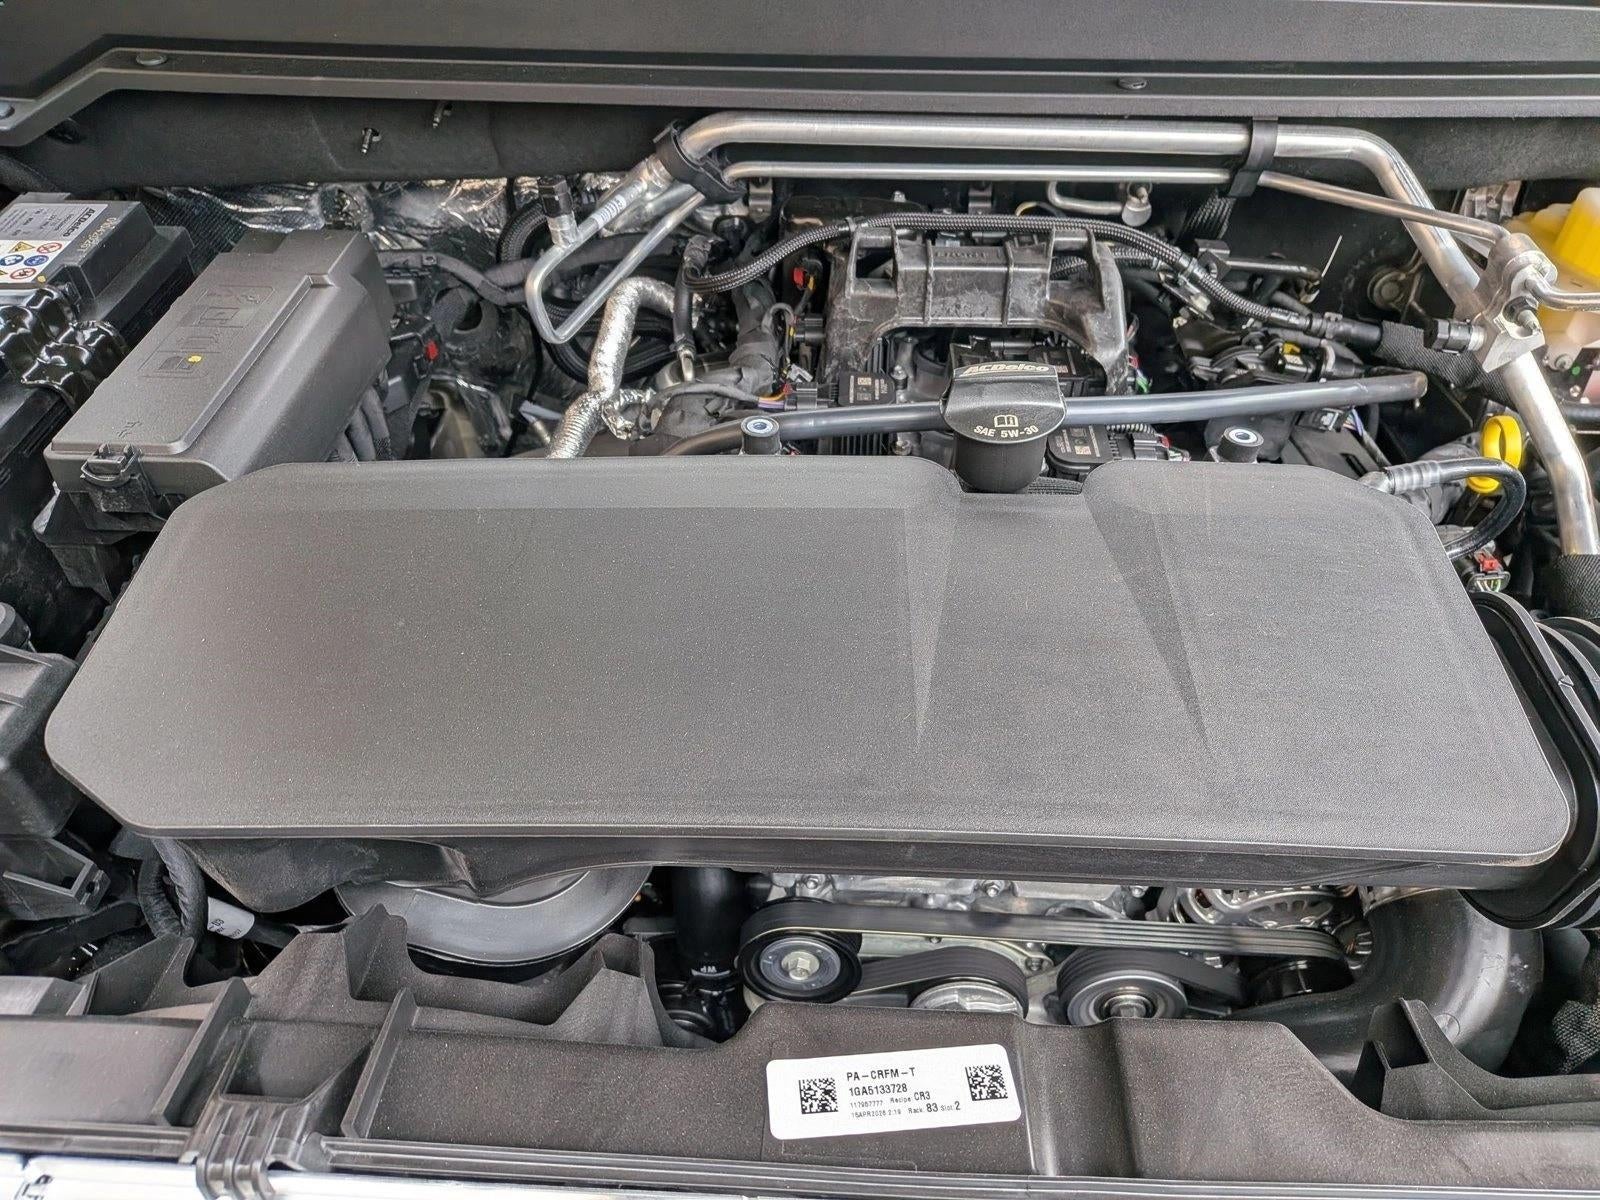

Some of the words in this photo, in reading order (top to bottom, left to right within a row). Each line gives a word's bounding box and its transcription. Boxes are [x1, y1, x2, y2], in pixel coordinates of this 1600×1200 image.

[63, 208, 95, 237] ACDelco
[962, 363, 1050, 375] ACDelco
[973, 425, 996, 438] SAE
[1000, 425, 1039, 438] 5W-30
[847, 1067, 915, 1081] PA-CRFM-T
[849, 1083, 908, 1096] 1GA5133728
[913, 1091, 931, 1101] CR3
[925, 1103, 939, 1113] 83
[953, 1101, 961, 1111] 2
